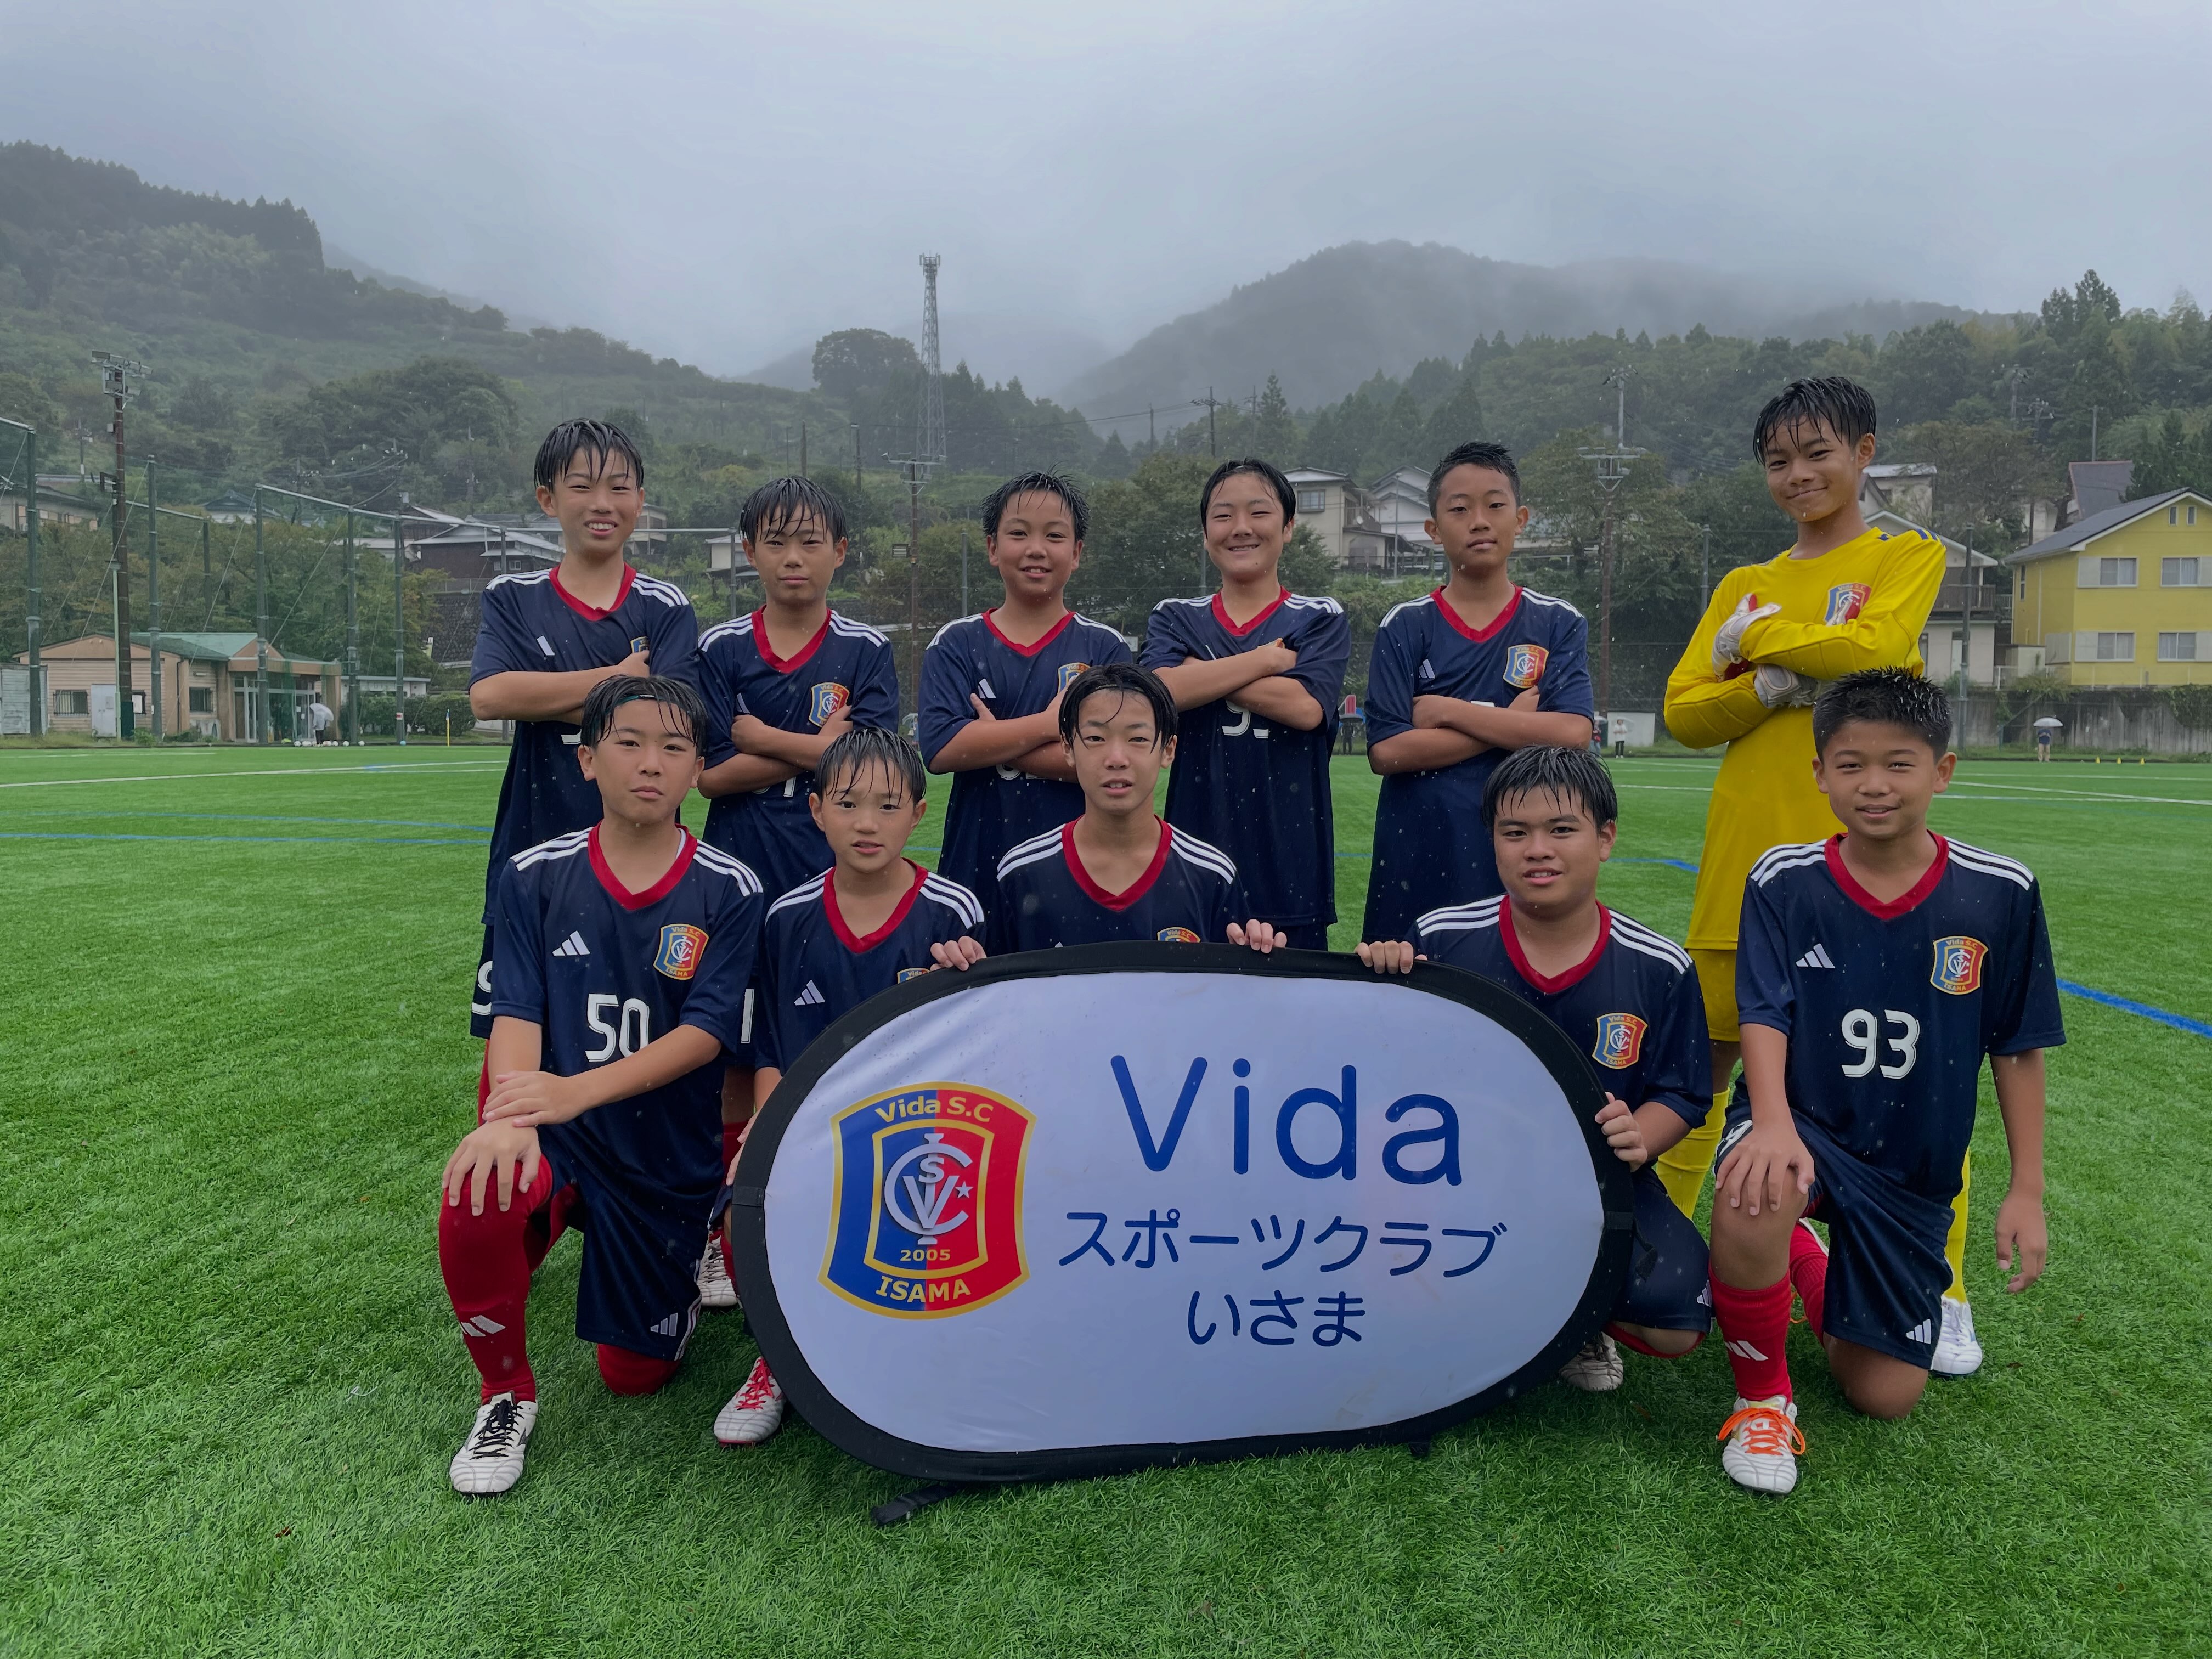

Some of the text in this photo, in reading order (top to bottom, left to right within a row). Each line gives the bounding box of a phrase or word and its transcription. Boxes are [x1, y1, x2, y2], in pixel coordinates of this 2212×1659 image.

[585, 993, 650, 1062] 50
[1841, 1008, 1920, 1079] 93
[874, 1096, 994, 1123] Vida S.C
[1110, 1054, 1462, 1186] Vida
[900, 1249, 951, 1262] 2005
[1059, 1208, 1508, 1278] スポーツクラブ
[876, 1276, 972, 1303] ISAMA
[1188, 1290, 1365, 1347] いさま
